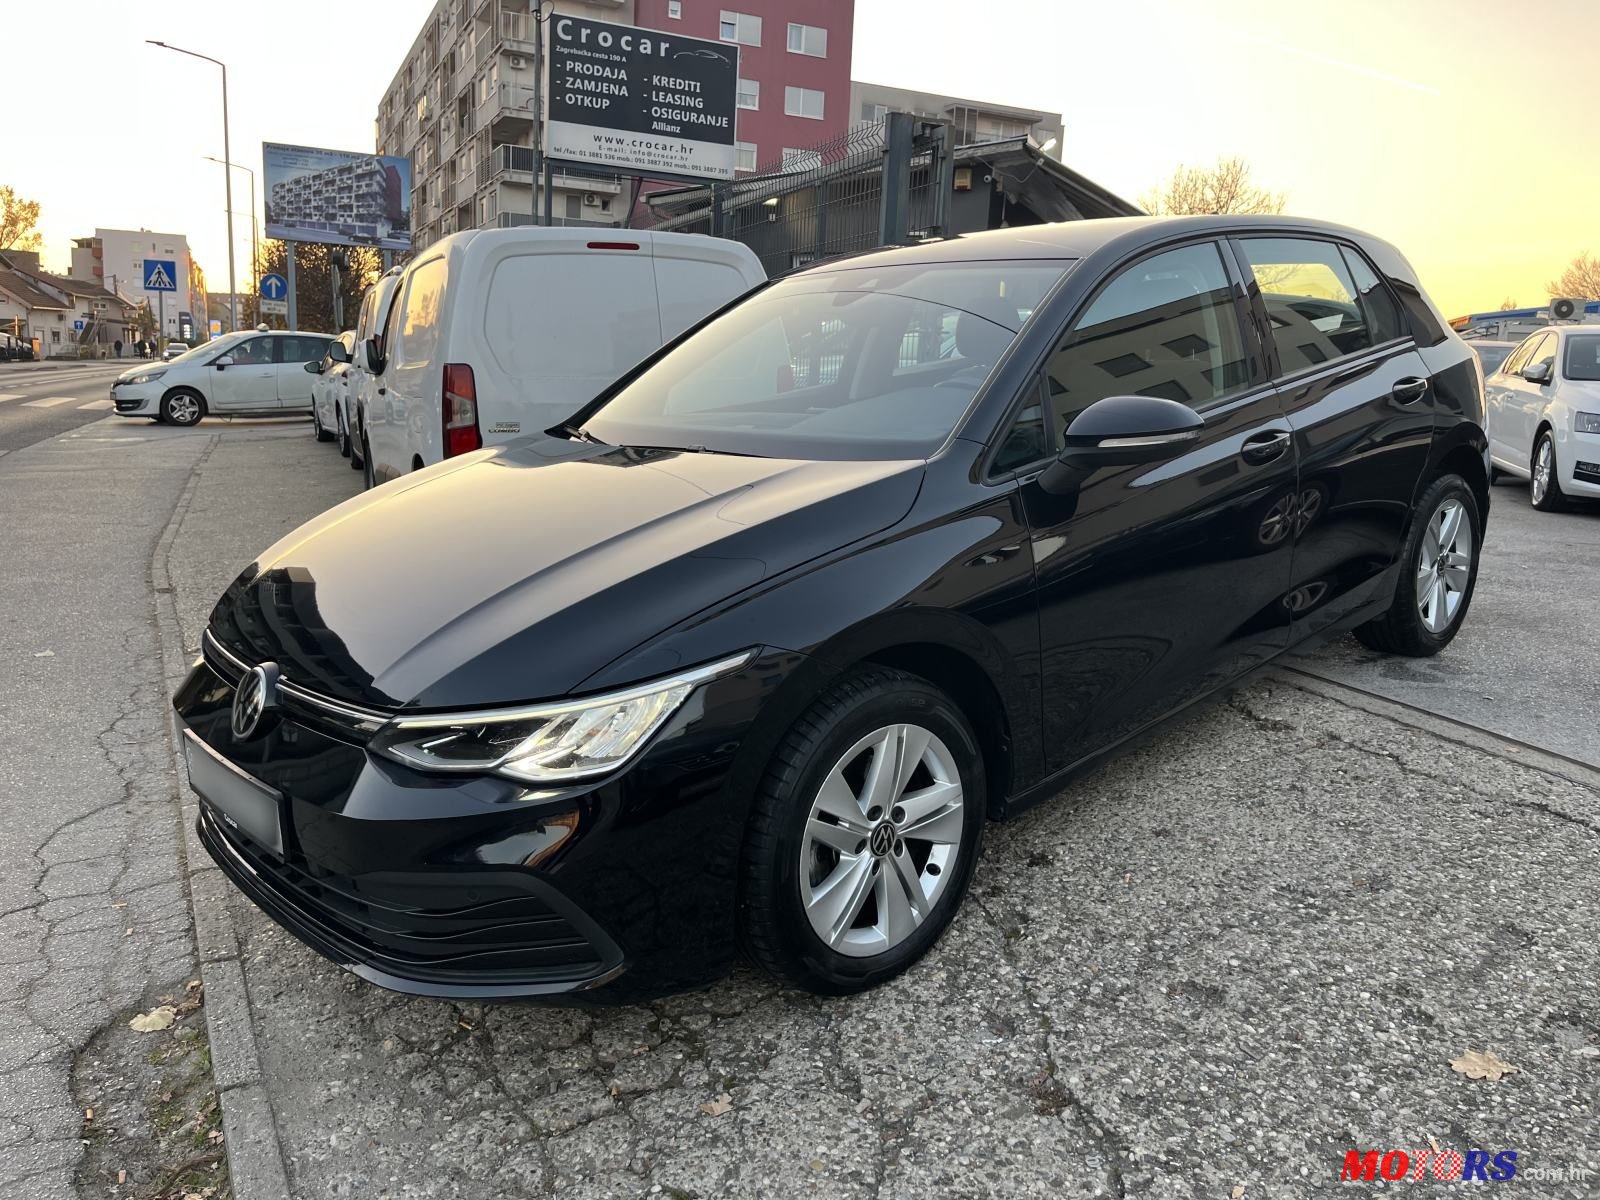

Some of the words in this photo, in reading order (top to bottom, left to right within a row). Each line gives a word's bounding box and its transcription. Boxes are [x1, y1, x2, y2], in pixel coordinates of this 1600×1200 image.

[556, 19, 670, 57] Crocar
[566, 60, 628, 81] PRODAJA
[565, 76, 629, 97] ZAMJENA
[652, 74, 701, 93] KREDITI
[565, 93, 610, 110] OTKUP
[652, 90, 704, 109] LEASING
[651, 106, 729, 128] OSIGURANJE
[651, 121, 681, 134] Allianz
[593, 135, 694, 154] www.crocar.hr
